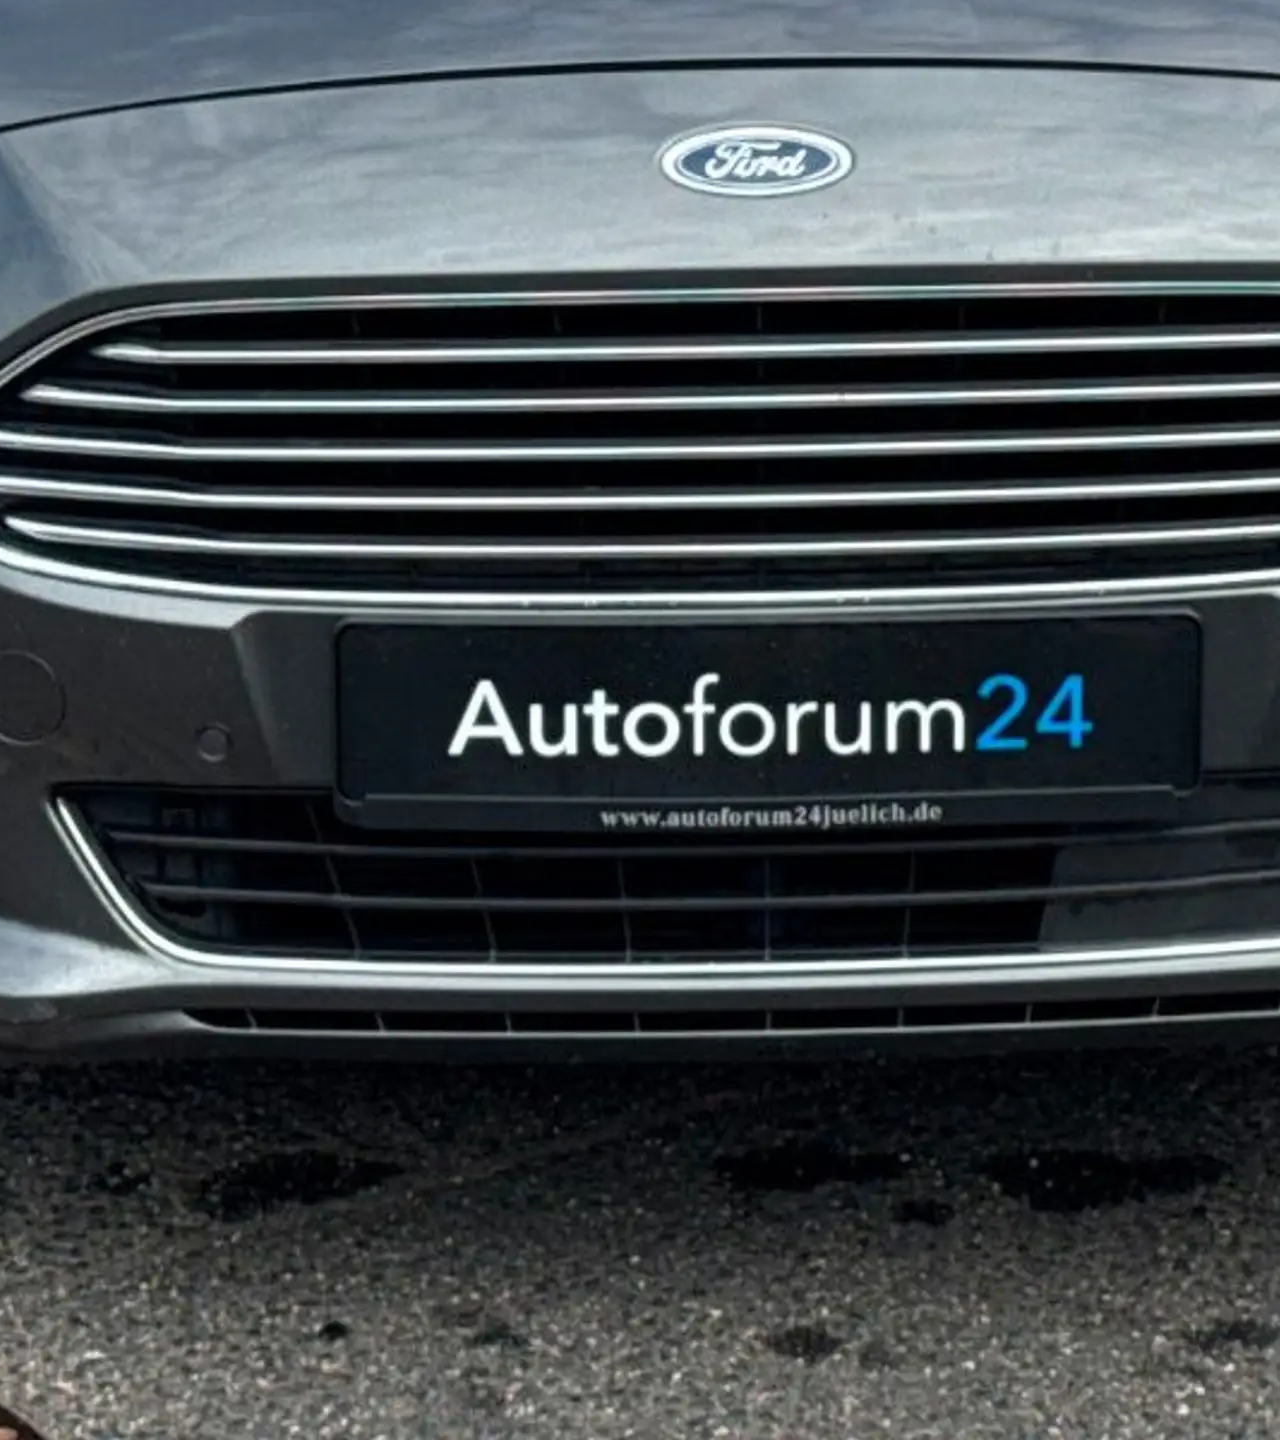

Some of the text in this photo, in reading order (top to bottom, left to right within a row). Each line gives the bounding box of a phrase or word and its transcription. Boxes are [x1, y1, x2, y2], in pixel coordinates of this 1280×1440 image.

[704, 141, 807, 178] Ford
[447, 672, 1093, 757] Autoforum24
[599, 801, 944, 830] www.autoforum24juelich.de
